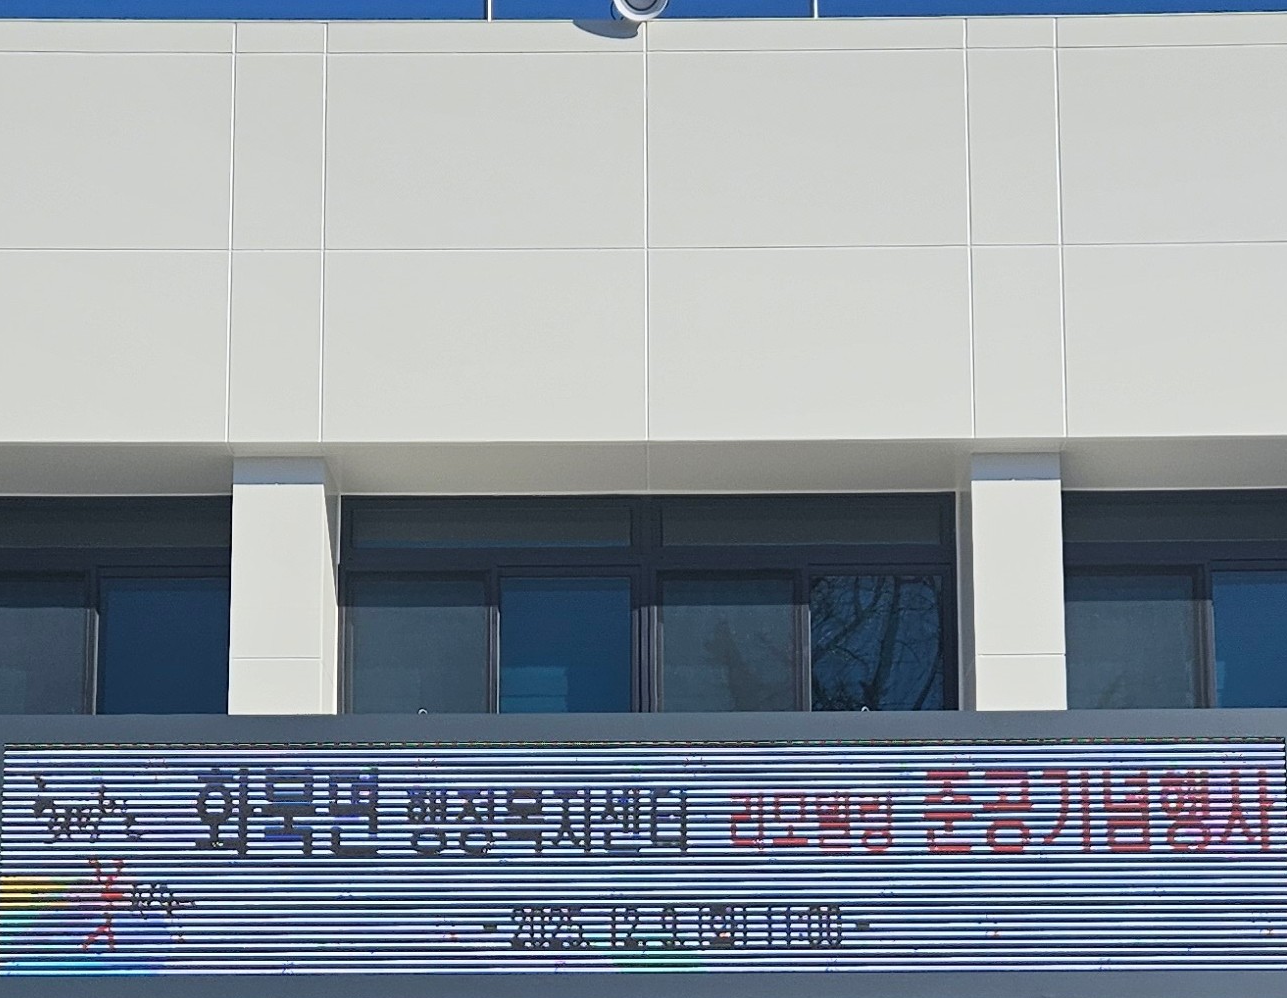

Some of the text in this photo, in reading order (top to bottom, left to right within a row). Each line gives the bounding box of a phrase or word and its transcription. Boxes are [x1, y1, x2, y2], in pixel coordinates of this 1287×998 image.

[195, 767, 1277, 857] 화북면 행정복지센터 리모델링 준공기념행사
[511, 904, 591, 950] 2025.
[767, 904, 843, 950] 11:00
